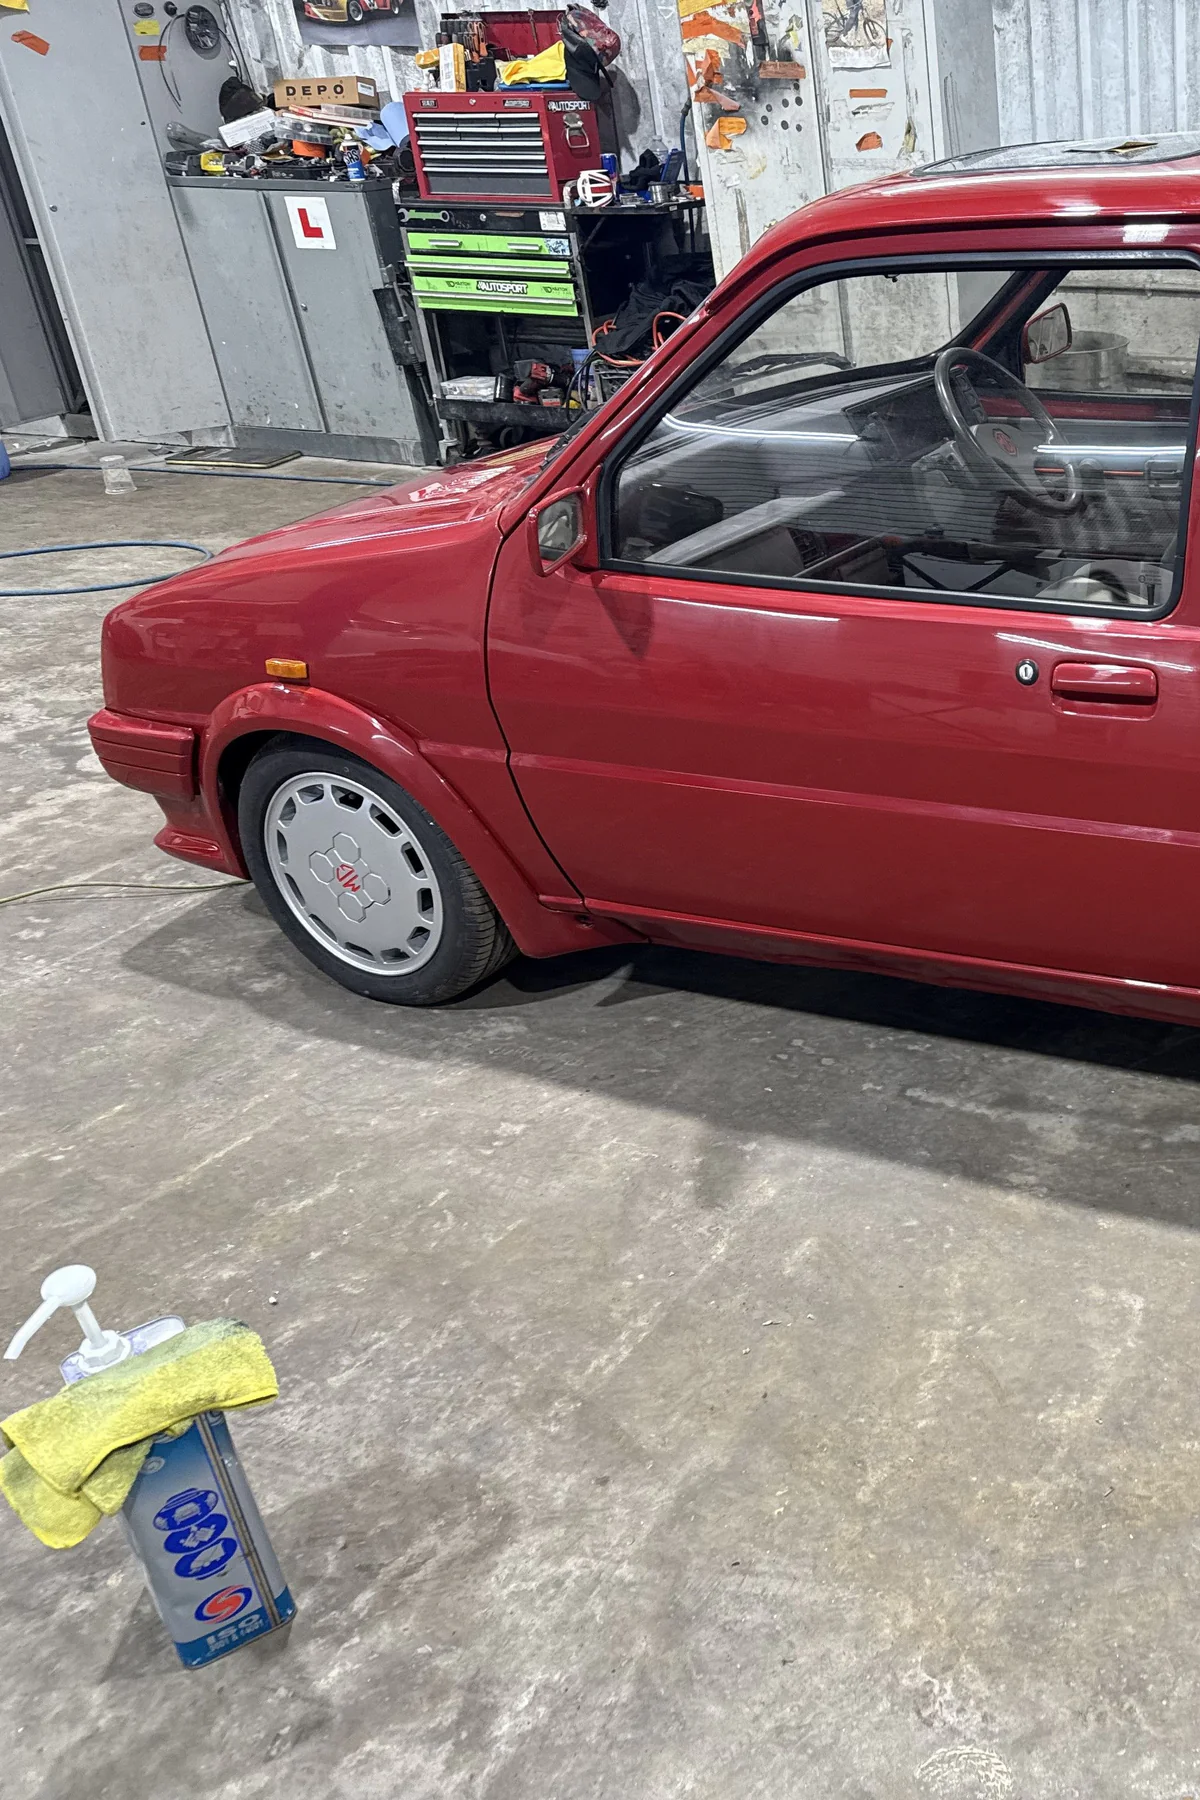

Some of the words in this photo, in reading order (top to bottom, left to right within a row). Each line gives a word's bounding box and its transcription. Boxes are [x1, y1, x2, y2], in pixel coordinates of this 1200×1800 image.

[285, 84, 345, 97] DEPO
[297, 208, 324, 238] L
[477, 281, 528, 294] AUTOSPORT
[335, 864, 361, 893] MG
